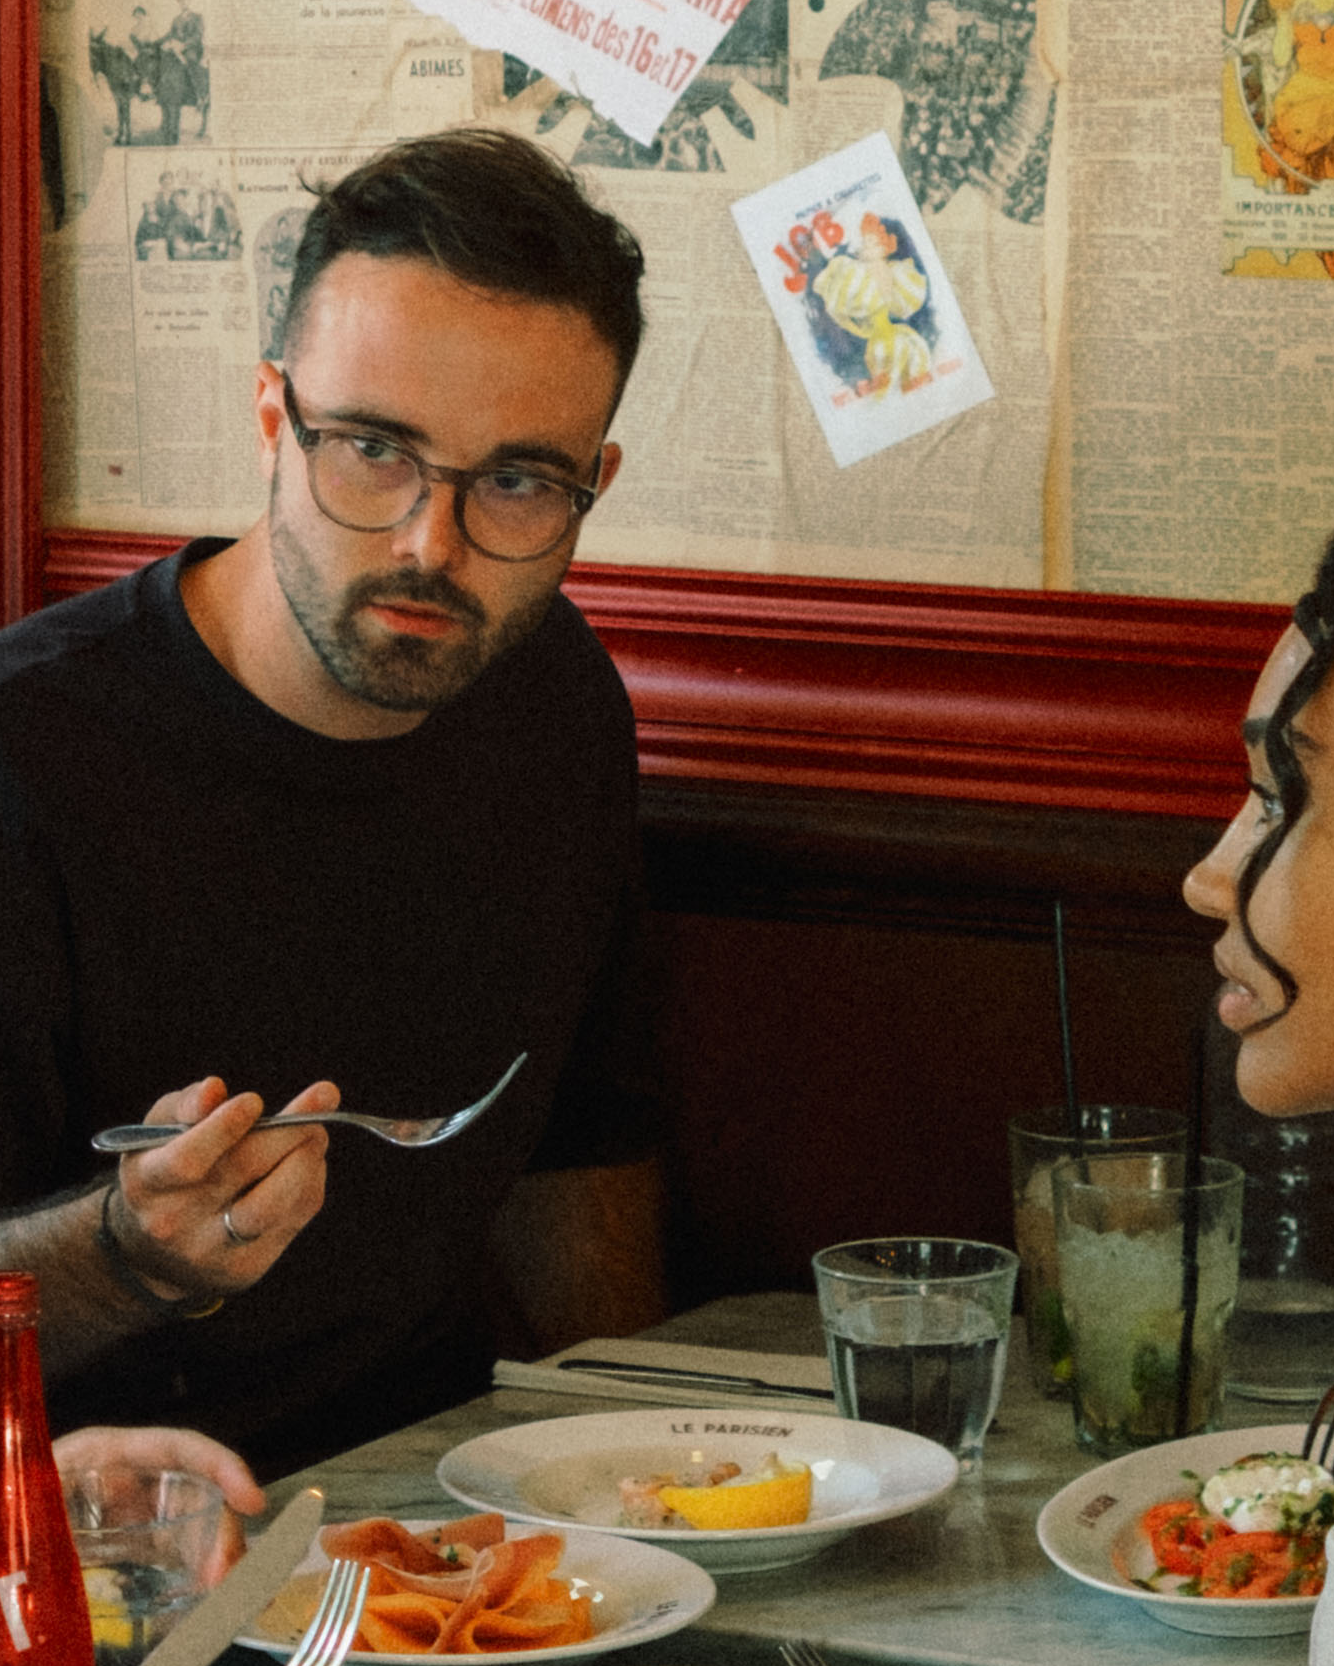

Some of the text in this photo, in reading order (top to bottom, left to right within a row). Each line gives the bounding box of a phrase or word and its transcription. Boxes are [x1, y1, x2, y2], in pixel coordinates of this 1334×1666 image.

[409, 59, 466, 78] ABIMES
[773, 209, 846, 295] JOB
[671, 1423, 795, 1438] LE PARISIEN
